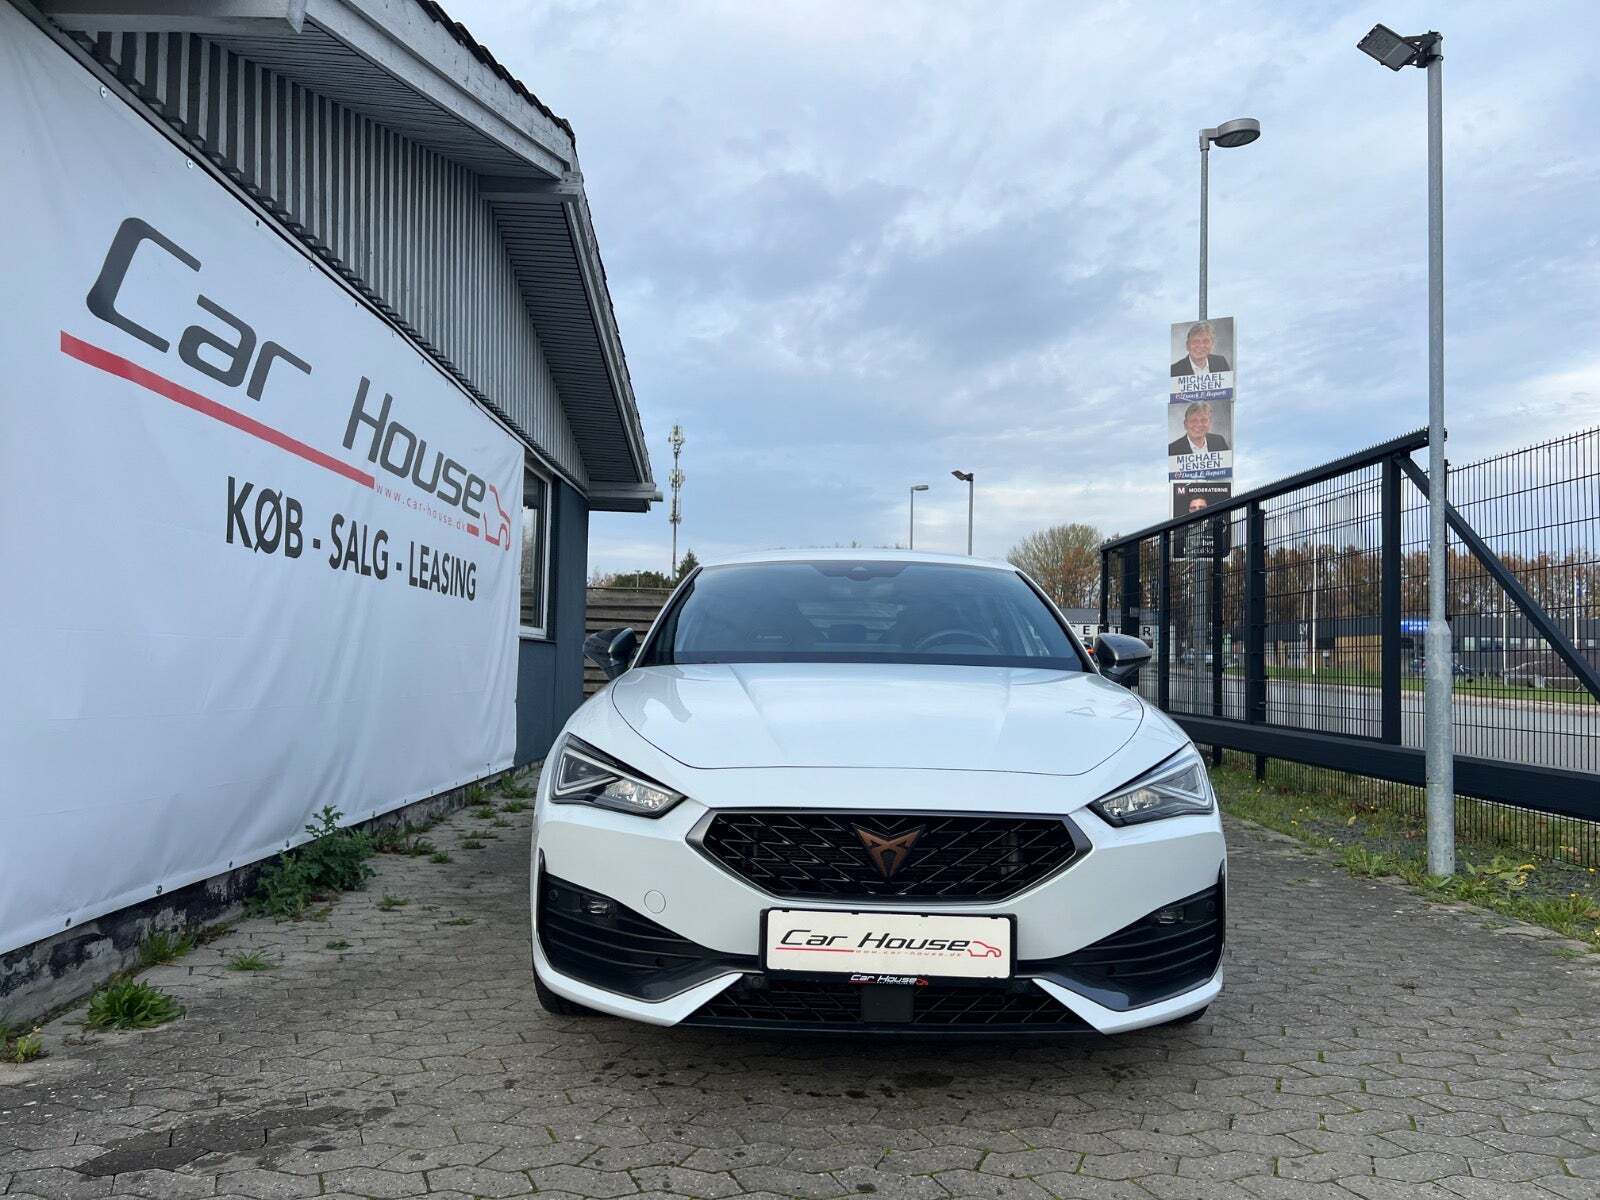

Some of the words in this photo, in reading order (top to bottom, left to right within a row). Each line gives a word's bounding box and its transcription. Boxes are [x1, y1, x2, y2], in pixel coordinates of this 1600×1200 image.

[86, 217, 312, 401] Car
[342, 376, 486, 518] House
[1178, 373, 1224, 384] MICHAEL
[1181, 382, 1222, 392] JENSEN
[1176, 452, 1223, 464] MICHAEL
[1179, 461, 1221, 471] JENSEN
[226, 475, 303, 558] KØB
[328, 513, 389, 580] SALG
[408, 541, 477, 601] LEASING
[780, 929, 848, 946] Car
[858, 932, 970, 951] House
[850, 974, 875, 982] Car
[877, 975, 917, 985] House
